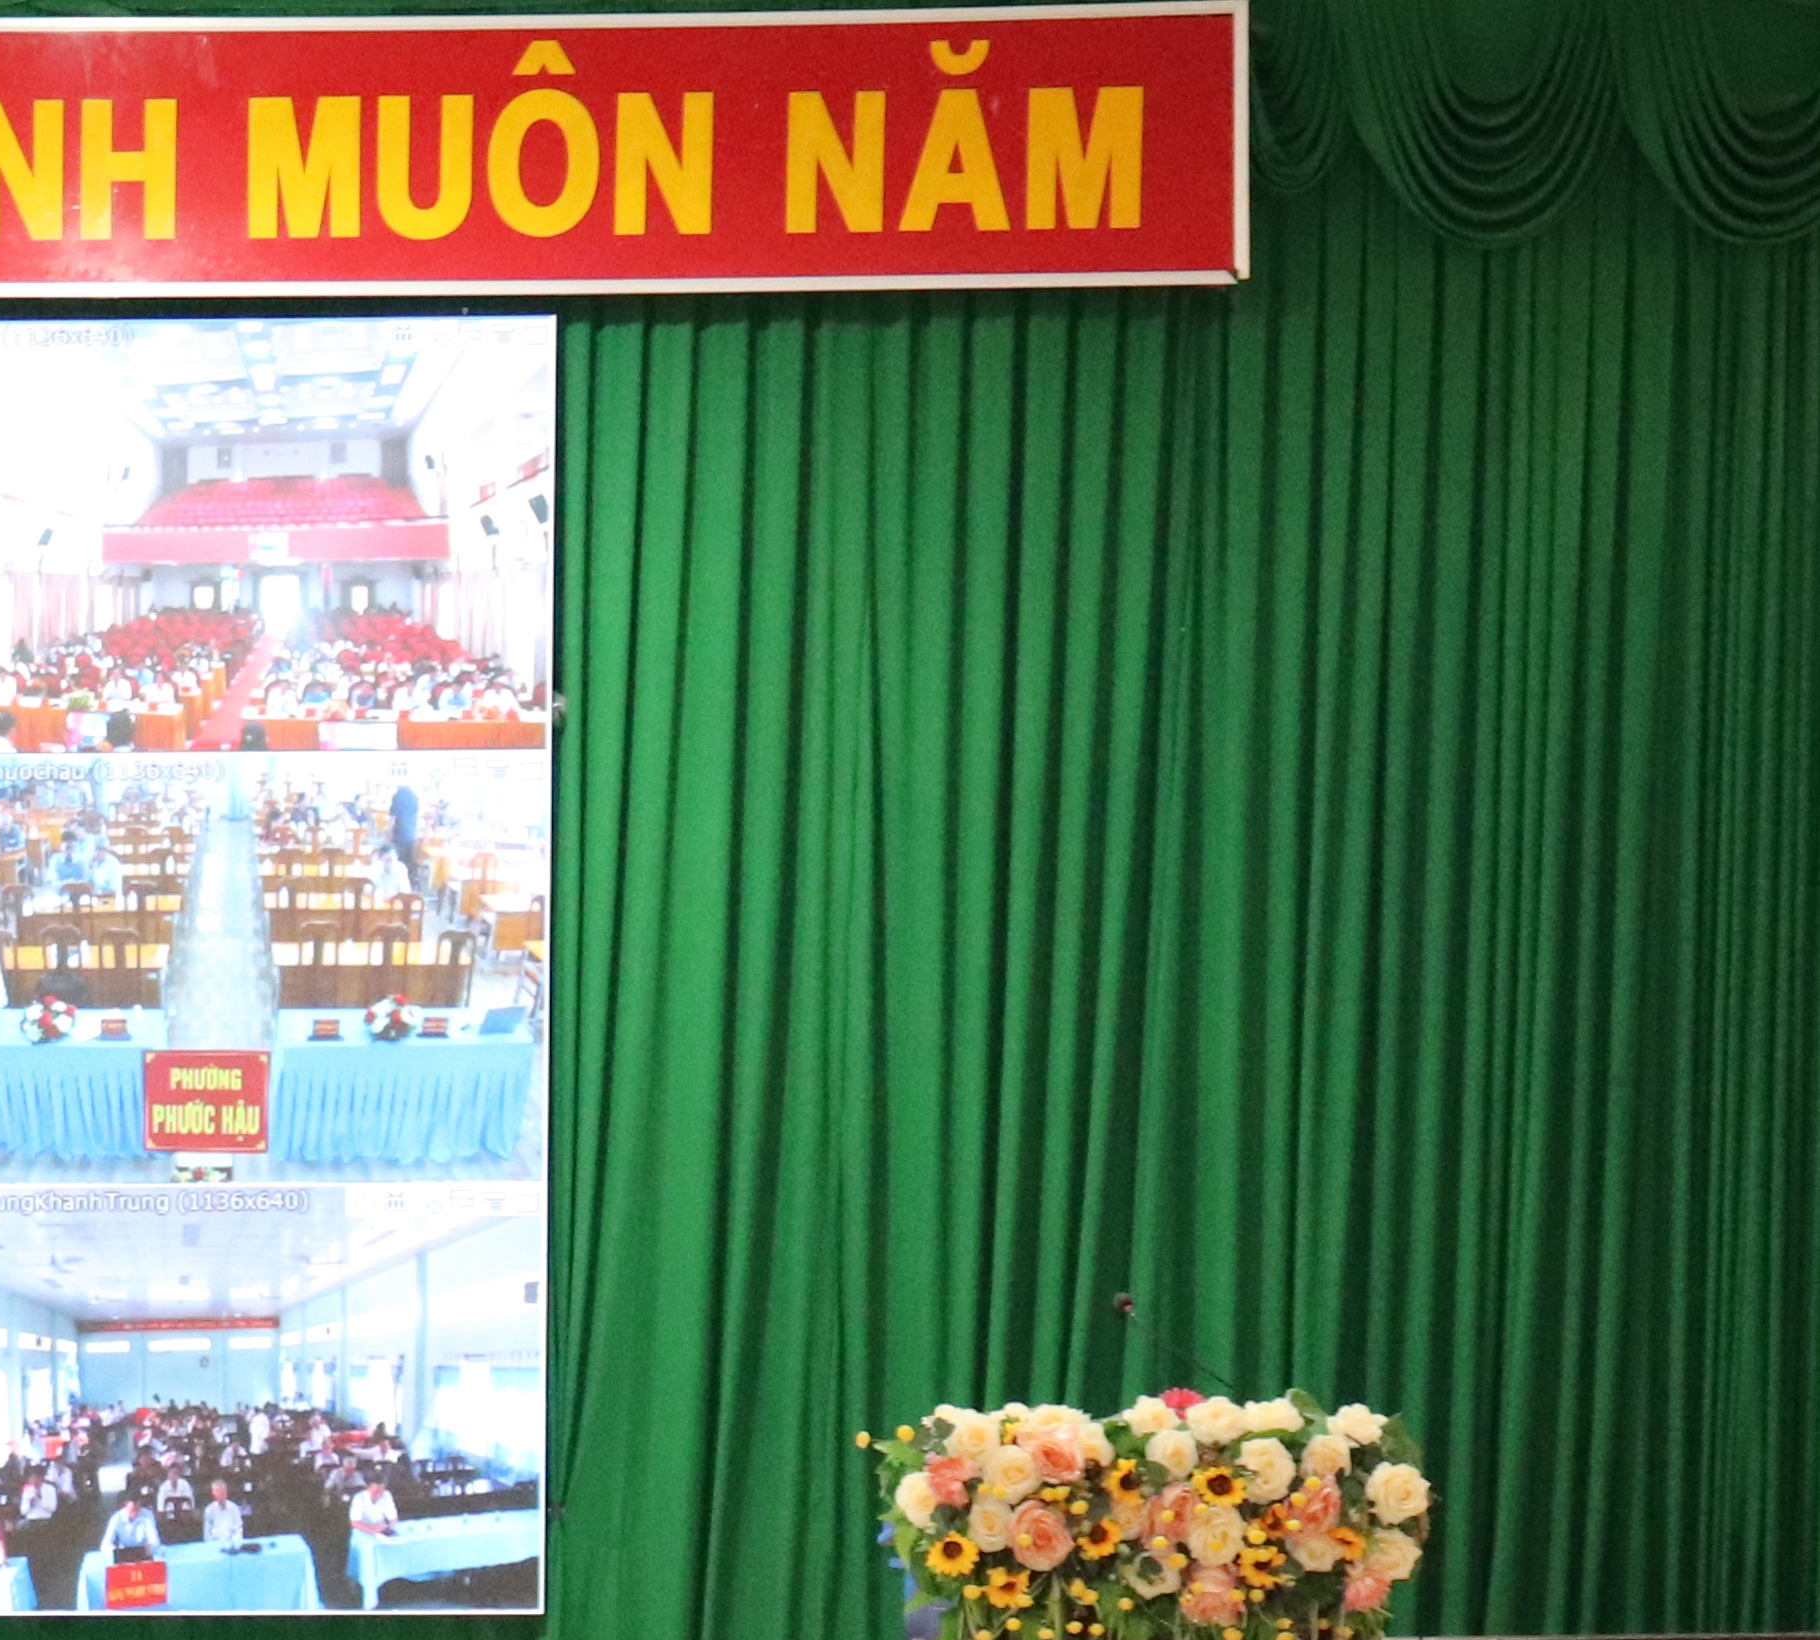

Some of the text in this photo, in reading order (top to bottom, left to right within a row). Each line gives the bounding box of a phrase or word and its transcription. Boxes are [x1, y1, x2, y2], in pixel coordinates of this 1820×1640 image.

[246, 40, 715, 241] MUÔN
[785, 40, 1144, 233] NĂM
[169, 1062, 243, 1091] PHƯỜNG
[151, 1098, 261, 1142] PHƯỚC HẬU
[176, 1190, 310, 1214] (1136x640)
